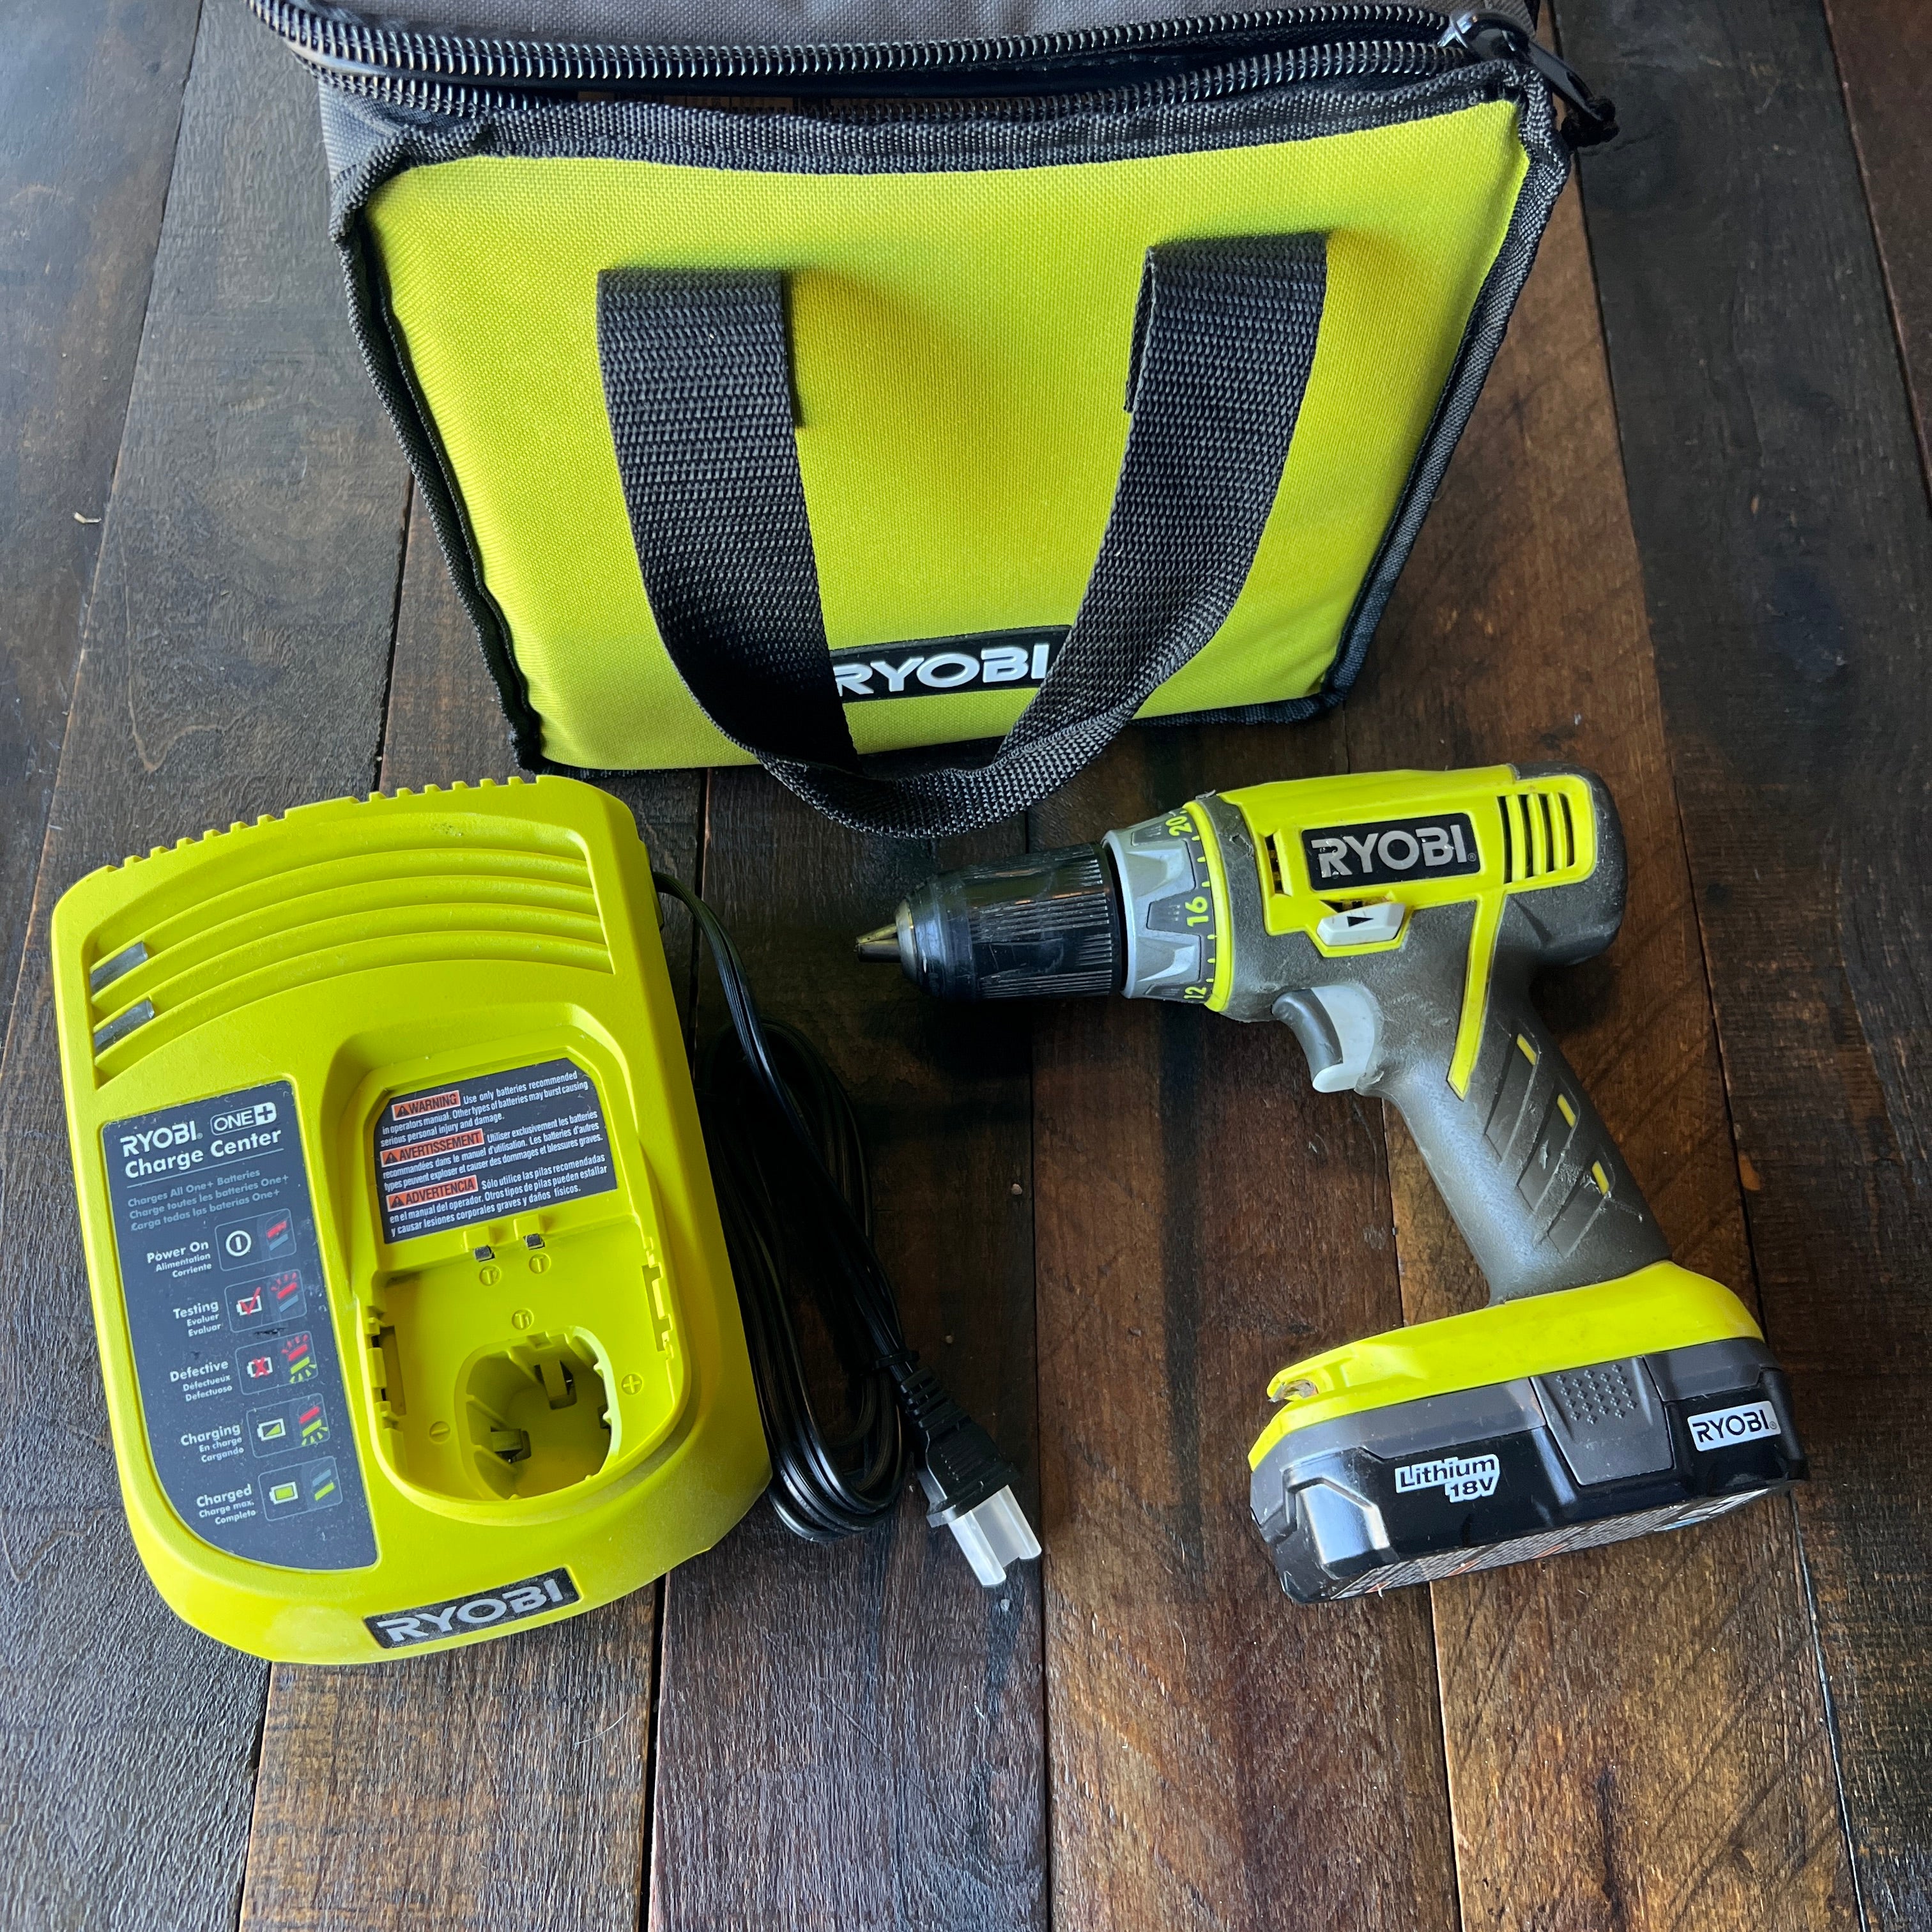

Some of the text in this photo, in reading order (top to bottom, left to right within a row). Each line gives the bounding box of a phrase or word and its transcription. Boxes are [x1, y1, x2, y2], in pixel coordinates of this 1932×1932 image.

[833, 643, 1050, 696] RYOBI
[1165, 815, 1192, 836] 20
[1311, 824, 1467, 878] RYOBI
[1185, 896, 1209, 927] 16
[1184, 986, 1207, 999] 12
[409, 1070, 578, 1114] WARNING Use only batteries recommended
[383, 1126, 389, 1135] in
[452, 1108, 471, 1119] Other
[471, 1104, 490, 1116] types
[498, 1095, 528, 1108] batteries
[529, 1092, 544, 1101] may
[544, 1086, 561, 1098] burst
[562, 1081, 588, 1094] causing
[120, 1121, 197, 1157] RYOBI
[381, 1113, 505, 1147] serious personal injury and damage.
[399, 1111, 597, 1162] AVERTISSEMENT Utiliser exclusivement les batteries
[125, 1130, 281, 1178] Charge Center
[383, 1161, 434, 1179] recommandées
[435, 1157, 452, 1167] dans
[453, 1154, 460, 1163] le
[461, 1147, 487, 1161] manuel
[529, 1136, 542, 1146] Les
[543, 1129, 572, 1142] batteries
[384, 1133, 603, 1192] types peuvent exploser et causer des dommages et blessures graves.
[128, 1193, 167, 1207] Charges
[171, 1186, 183, 1197] All
[217, 1170, 260, 1185] Batteries
[406, 1154, 605, 1204] ADVERTENCIA Sólo utilice las pilas recomendadas
[130, 1206, 165, 1219] Charge
[167, 1197, 197, 1209] toutes
[199, 1194, 213, 1202] les
[215, 1183, 258, 1198] batteries
[390, 1165, 607, 1223] en el manual del operador. Otros tipos de pilas pueden estallar
[164, 1212, 190, 1223] todas
[192, 1208, 207, 1216] las
[210, 1197, 250, 1212] baterías
[391, 1228, 396, 1238] y
[397, 1221, 422, 1234] causar
[424, 1214, 455, 1225] lesiones
[456, 1204, 495, 1220] corporales
[496, 1199, 521, 1213] graves
[523, 1197, 527, 1206] y
[529, 1190, 551, 1203] daños
[147, 1241, 209, 1264] Power On
[156, 1254, 211, 1271] Alimentation
[172, 1263, 212, 1278] Corriente
[173, 1301, 218, 1319] Testing
[187, 1314, 219, 1326] Evaluer
[188, 1324, 221, 1337] Evaluar
[170, 1361, 229, 1382] Defective
[185, 1386, 233, 1402] Defectuoso
[181, 1425, 241, 1446] Charging
[1692, 1409, 1769, 1443] RYOBI
[201, 1447, 244, 1462] Cargando
[212, 1438, 242, 1449] charge
[1400, 1459, 1495, 1487] Lithium
[1450, 1476, 1494, 1497] 18V
[197, 1483, 252, 1507] Charged
[199, 1506, 230, 1517] Charge
[215, 1510, 256, 1524] Completo
[376, 1579, 564, 1642] RYOBI
